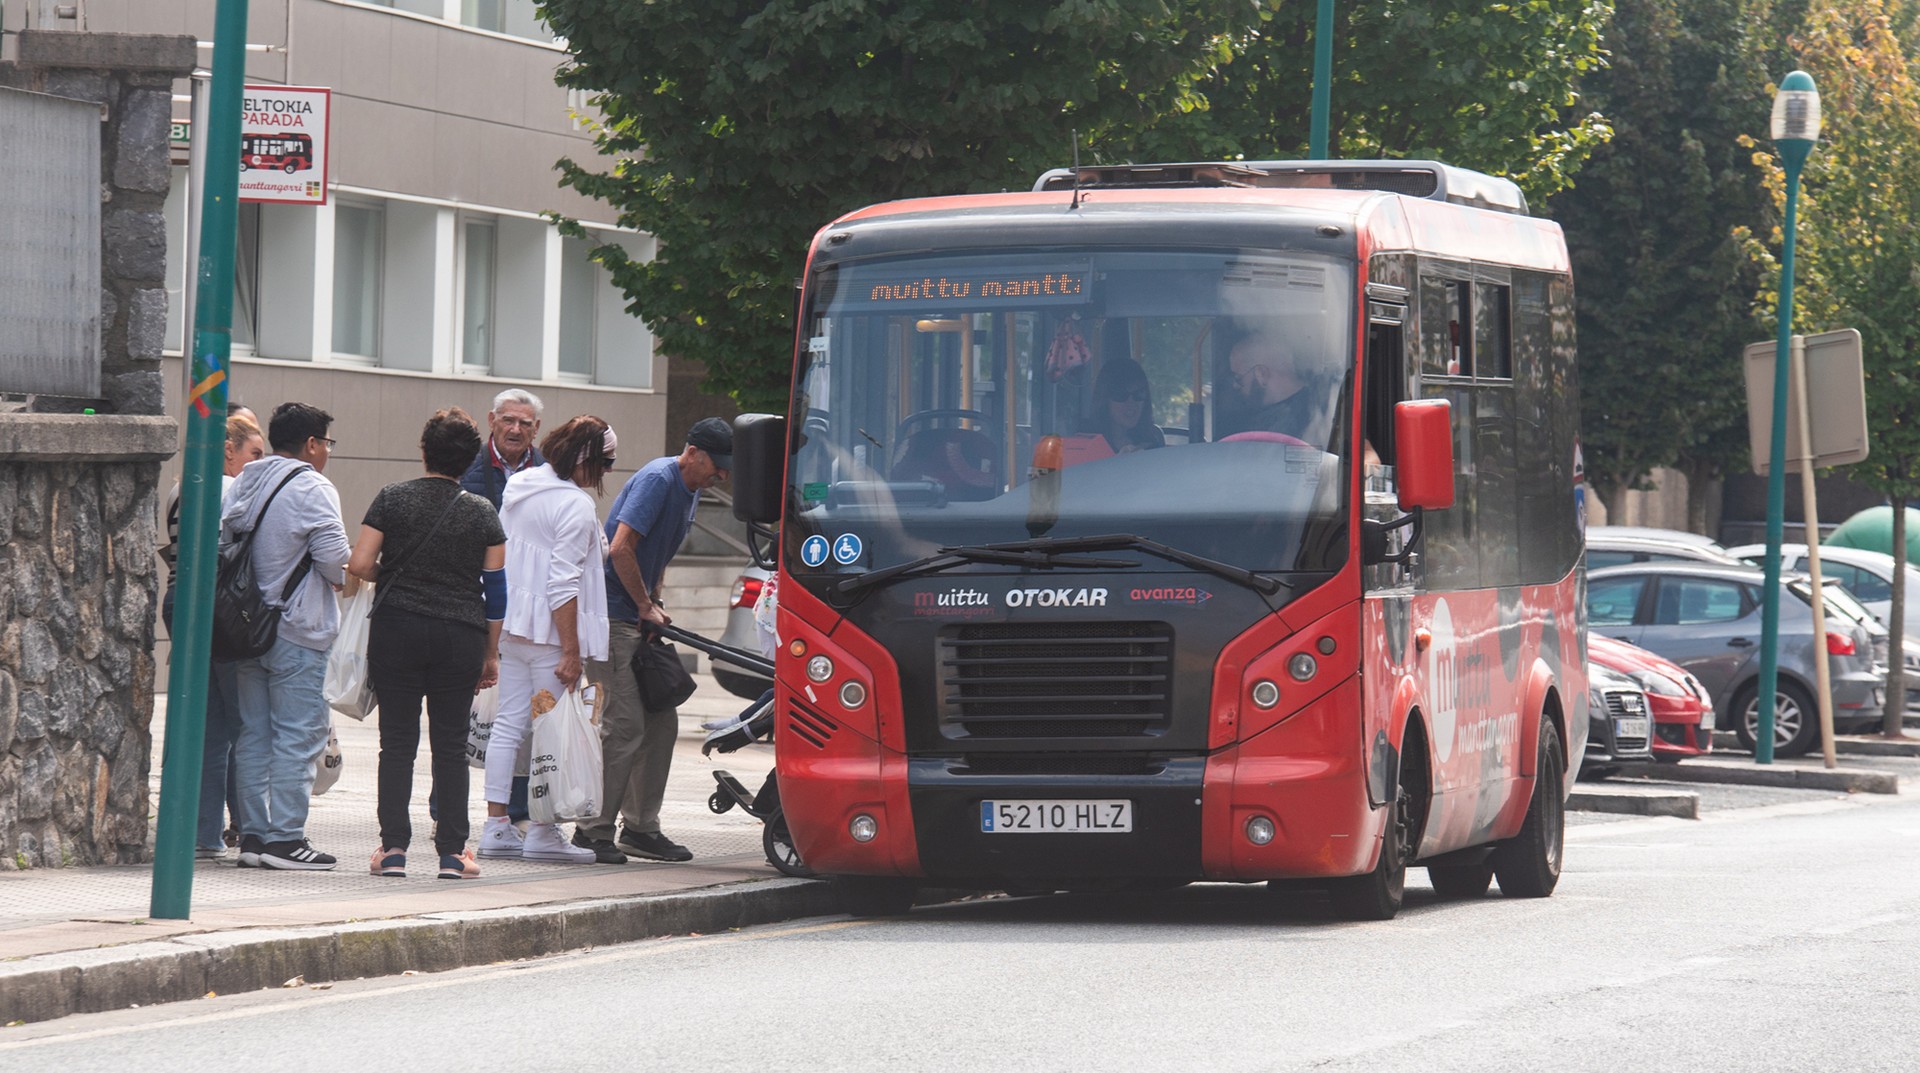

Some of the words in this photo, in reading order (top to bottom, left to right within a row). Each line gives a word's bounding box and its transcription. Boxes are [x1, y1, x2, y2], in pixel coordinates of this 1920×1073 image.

[243, 99, 312, 114] ELTOKIA
[871, 277, 970, 300] muittu
[914, 588, 989, 607] muittu
[1005, 588, 1108, 608] OTOKAR
[1130, 587, 1196, 601] avanza
[1000, 804, 1065, 828] 5210
[1075, 804, 1125, 828] HLZ
